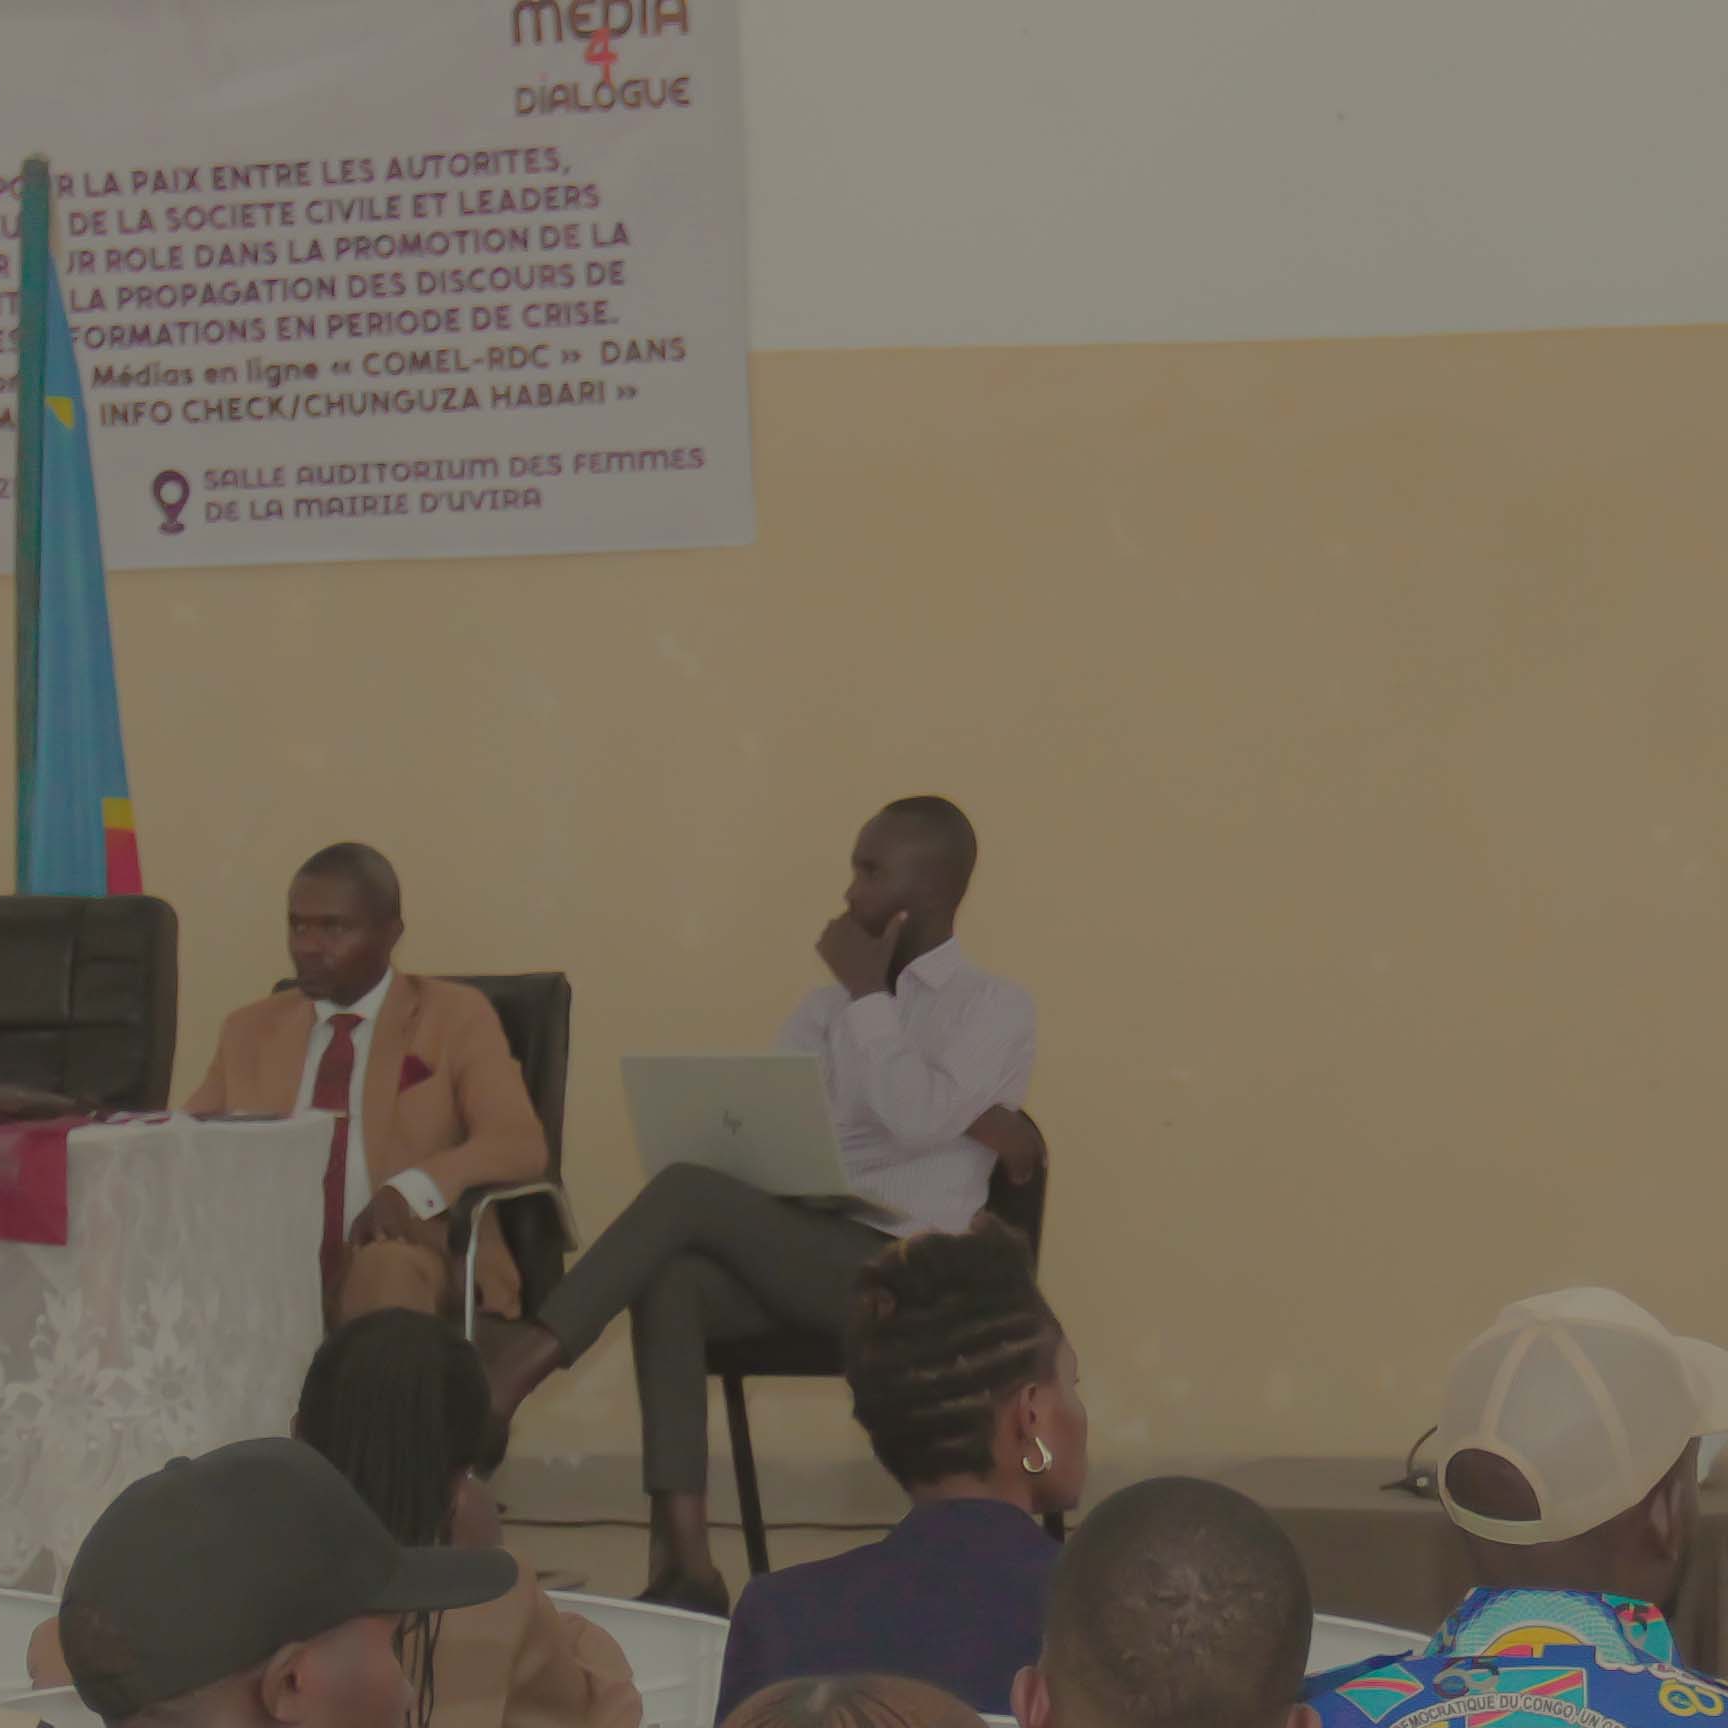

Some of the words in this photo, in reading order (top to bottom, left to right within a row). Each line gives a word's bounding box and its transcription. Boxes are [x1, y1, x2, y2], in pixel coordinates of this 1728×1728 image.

[583, 27, 619, 84] 4
[513, 75, 691, 115] DIALOGUE
[83, 171, 123, 199] LA
[131, 167, 201, 194] PAIX
[210, 160, 313, 193] ENTRE
[321, 157, 376, 187] LES
[384, 146, 571, 182] AUTORITES,
[68, 209, 108, 237] DE
[117, 207, 156, 236] LA
[164, 200, 296, 233] SOCIETE
[304, 194, 402, 225] CIVILE
[412, 191, 449, 220] ET
[458, 183, 601, 217] LEADERS
[104, 244, 185, 273] ROLE
[194, 240, 279, 270] DANS
[288, 238, 326, 265] LA
[334, 227, 529, 261] PROMOTION
[539, 223, 582, 252] DE
[591, 221, 631, 249] LA
[69, 287, 107, 314] LA
[117, 275, 337, 311] PROPAGATION
[347, 271, 407, 300] DES
[415, 263, 576, 297] DISCOURS
[585, 259, 625, 289] DE
[70, 316, 265, 350] FORMATIONS
[276, 314, 317, 342] EN
[326, 306, 461, 339] PERIODE
[471, 303, 513, 332] DE
[521, 299, 619, 330] CRISE.
[91, 362, 195, 389] Médias
[203, 365, 239, 385] en
[246, 357, 320, 390] ligne
[361, 343, 550, 379] COMEL-RDC
[599, 335, 687, 366] DANS
[100, 400, 173, 427] INFO
[181, 386, 481, 425] CHECK/CHUNGUZA
[490, 380, 606, 410] HABARI
[203, 465, 286, 491] SALLE
[295, 456, 500, 487] AUDITORIUM
[508, 453, 563, 479] DES
[572, 447, 706, 475] FEMMES
[204, 499, 241, 524] DE
[249, 498, 285, 521] LA
[293, 492, 409, 519] MAIRIE
[419, 486, 543, 515] D'UVIRA
[1499, 1694, 1521, 1708] DU
[1581, 1709, 1600, 1728] UN
